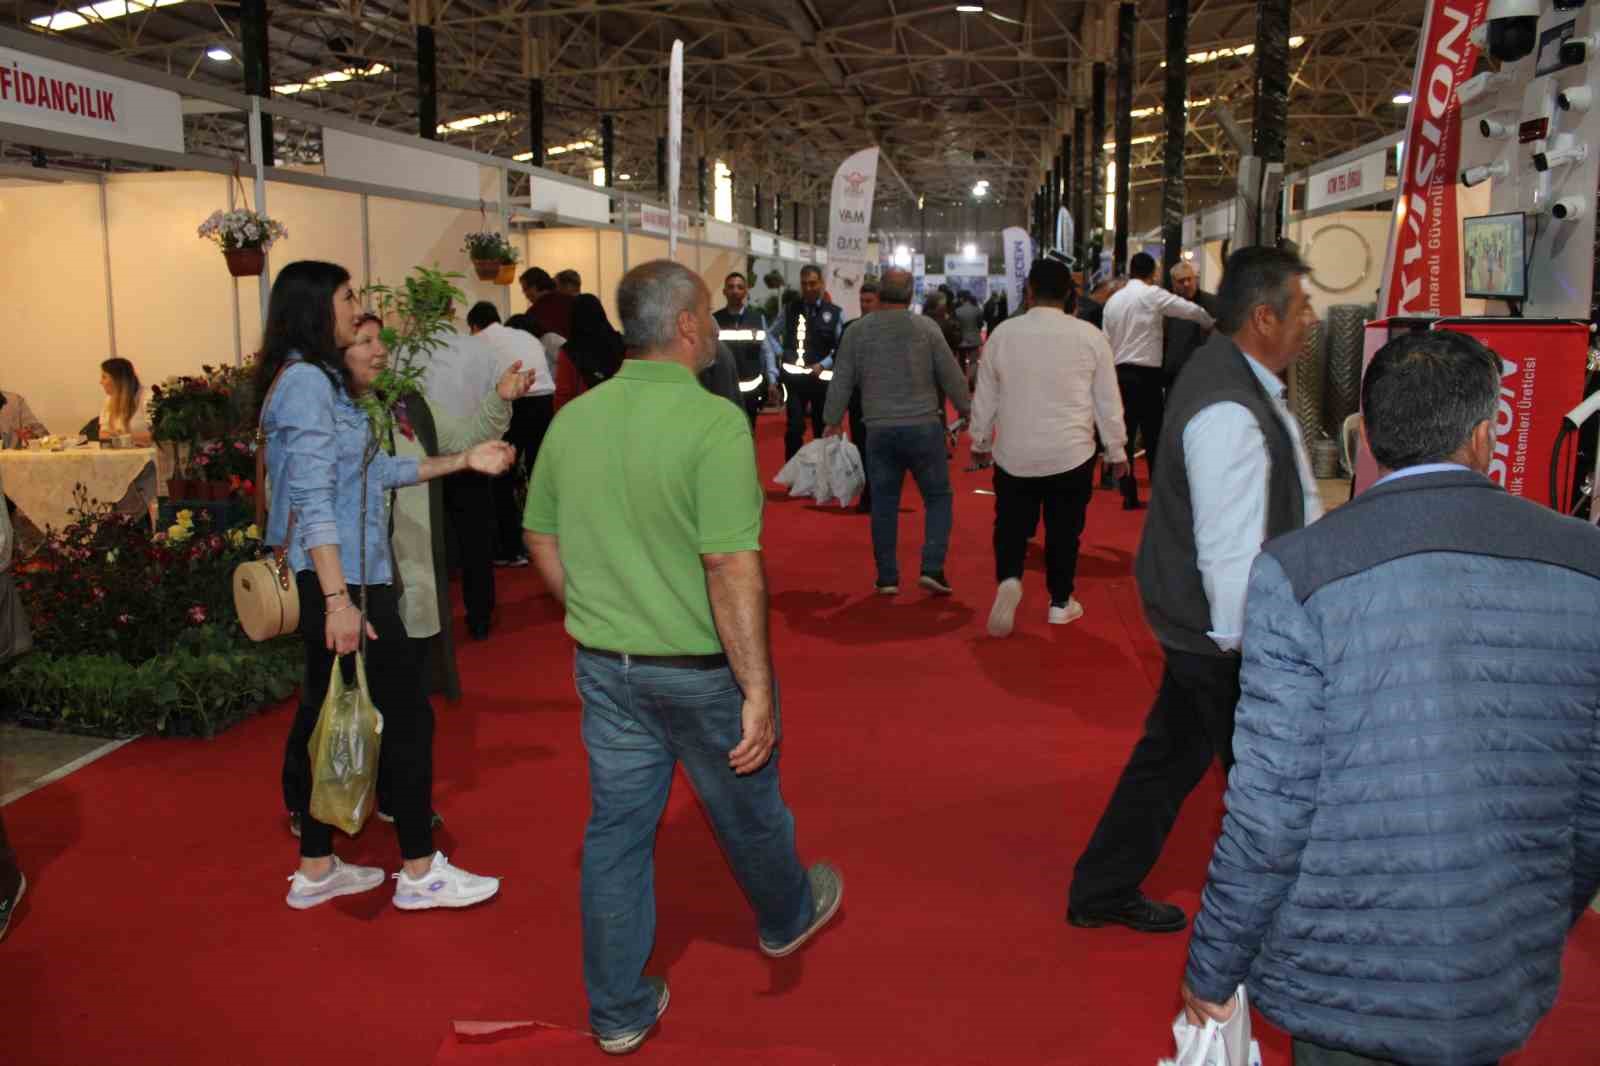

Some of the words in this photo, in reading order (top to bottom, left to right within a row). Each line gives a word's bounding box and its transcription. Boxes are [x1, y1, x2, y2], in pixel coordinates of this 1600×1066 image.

[0, 62, 116, 122] FİDANCILIK
[1428, 175, 1445, 249] Güvenlik
[1517, 357, 1537, 409] Üreticisi
[1512, 413, 1531, 473] Sistemleri
